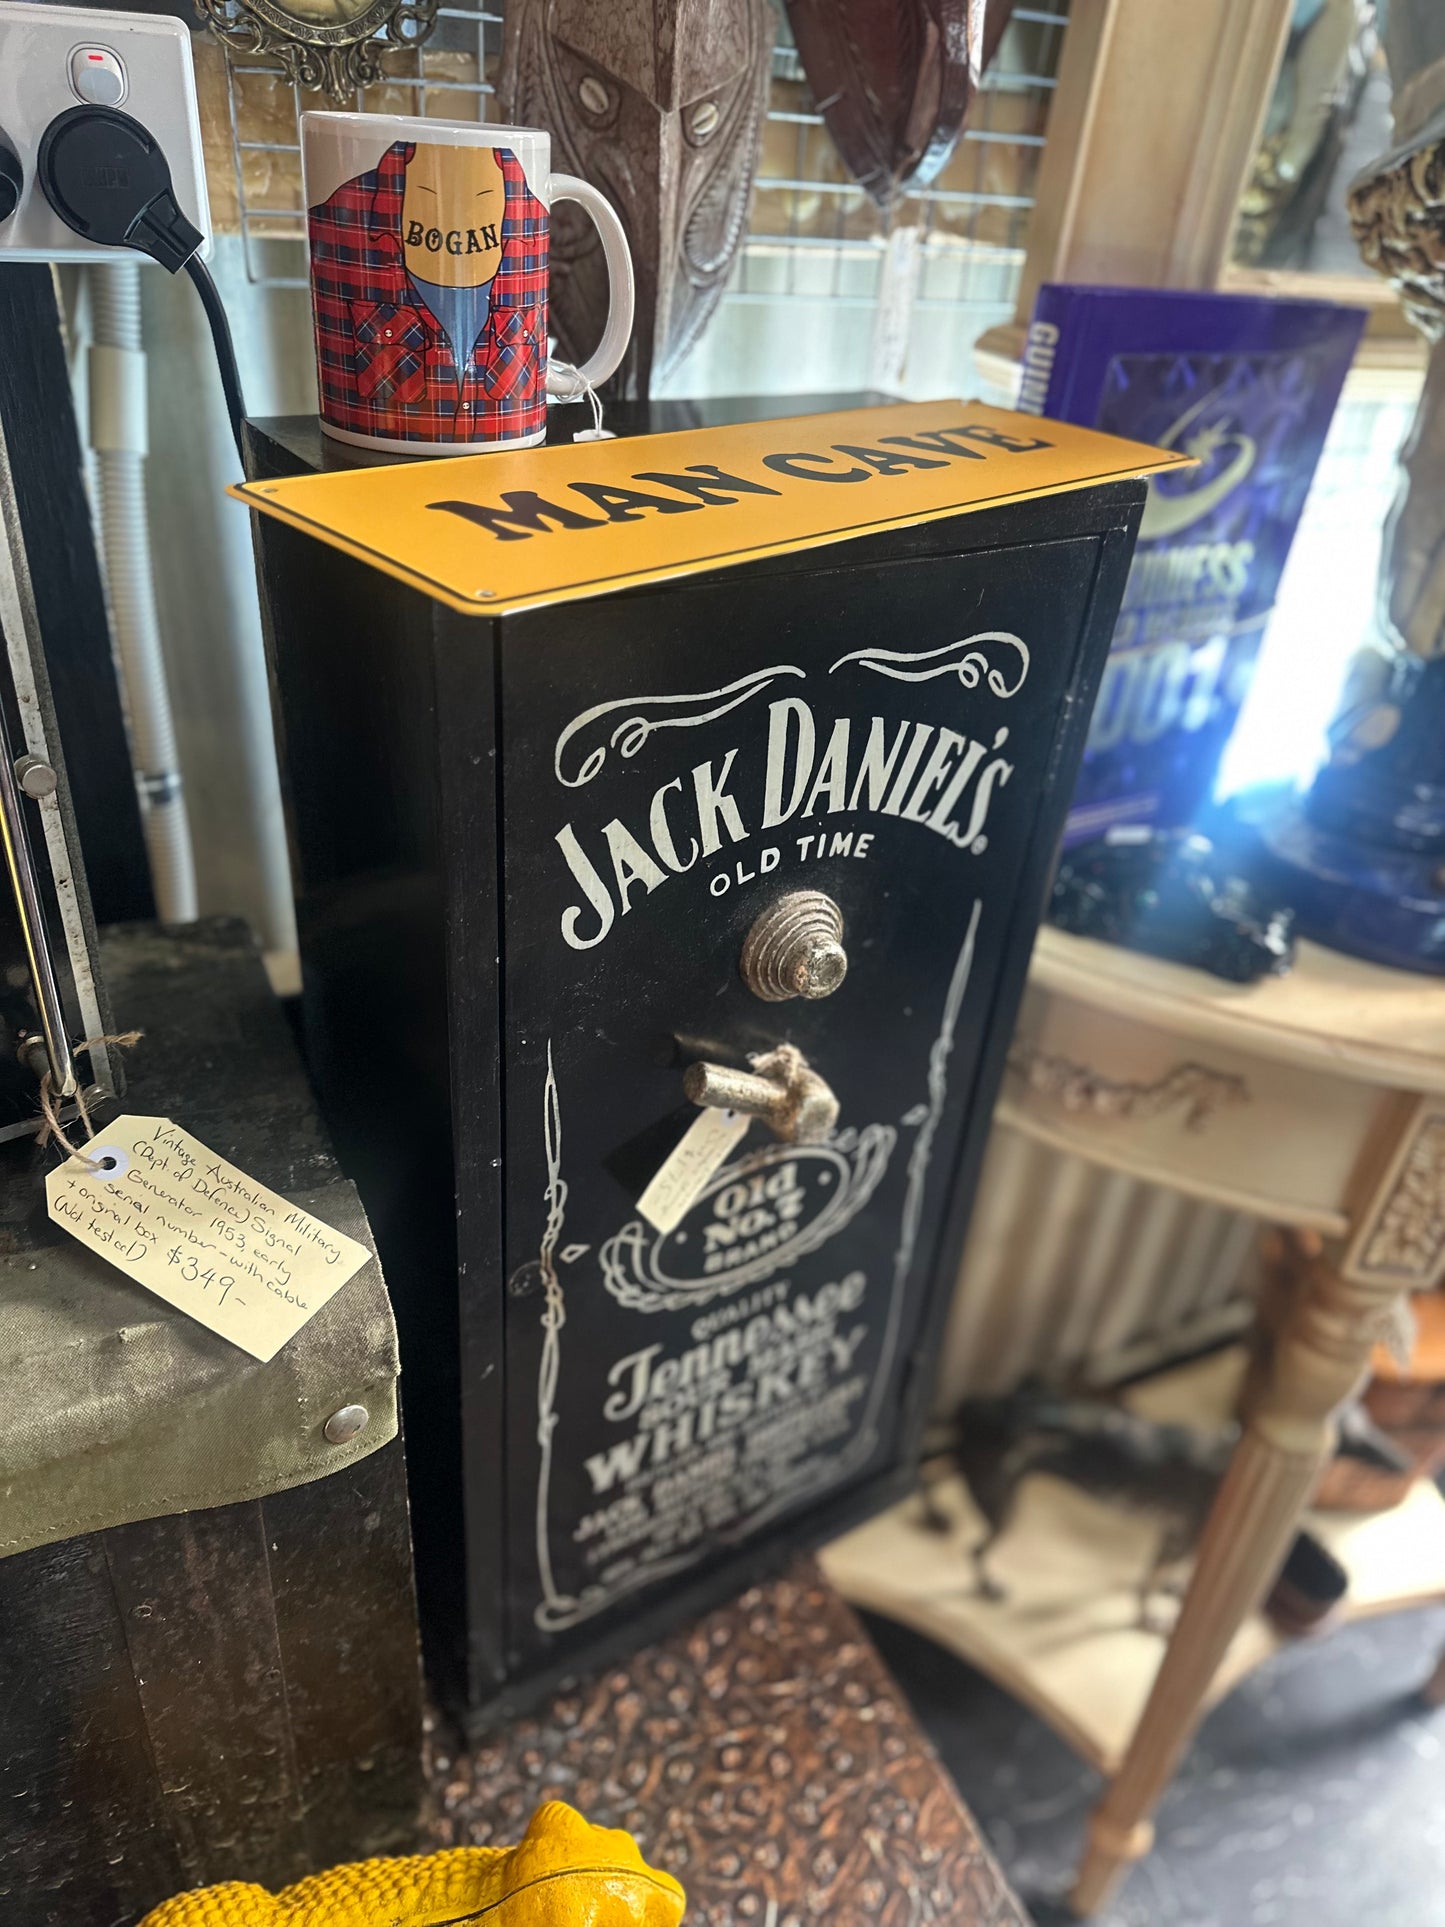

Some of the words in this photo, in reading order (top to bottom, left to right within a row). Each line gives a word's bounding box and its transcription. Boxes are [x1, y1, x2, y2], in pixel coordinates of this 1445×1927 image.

[405, 220, 500, 256] BOGAN
[425, 464, 783, 541] MAN
[762, 425, 1055, 484] CAVE
[554, 748, 750, 950] JACK
[709, 847, 781, 897] OLD
[796, 831, 876, 861] TIME
[54, 1194, 84, 1223] (Not
[104, 1183, 150, 1214] serial
[266, 1281, 308, 1310] cable
[127, 1169, 203, 1216] Generator
[210, 1218, 246, 1252] 1953,
[253, 1248, 292, 1286] early
[133, 1141, 170, 1171] (Dept.
[173, 1168, 194, 1182] of
[250, 1216, 302, 1256] Signal
[134, 1221, 158, 1244] box
[153, 1126, 196, 1167] Vintage
[206, 1164, 275, 1215] Australian
[284, 1212, 341, 1265] Military
[603, 1270, 867, 1422] Tennessee
[691, 1279, 791, 1341] QUALITY
[584, 1323, 868, 1494] WHISKEY
